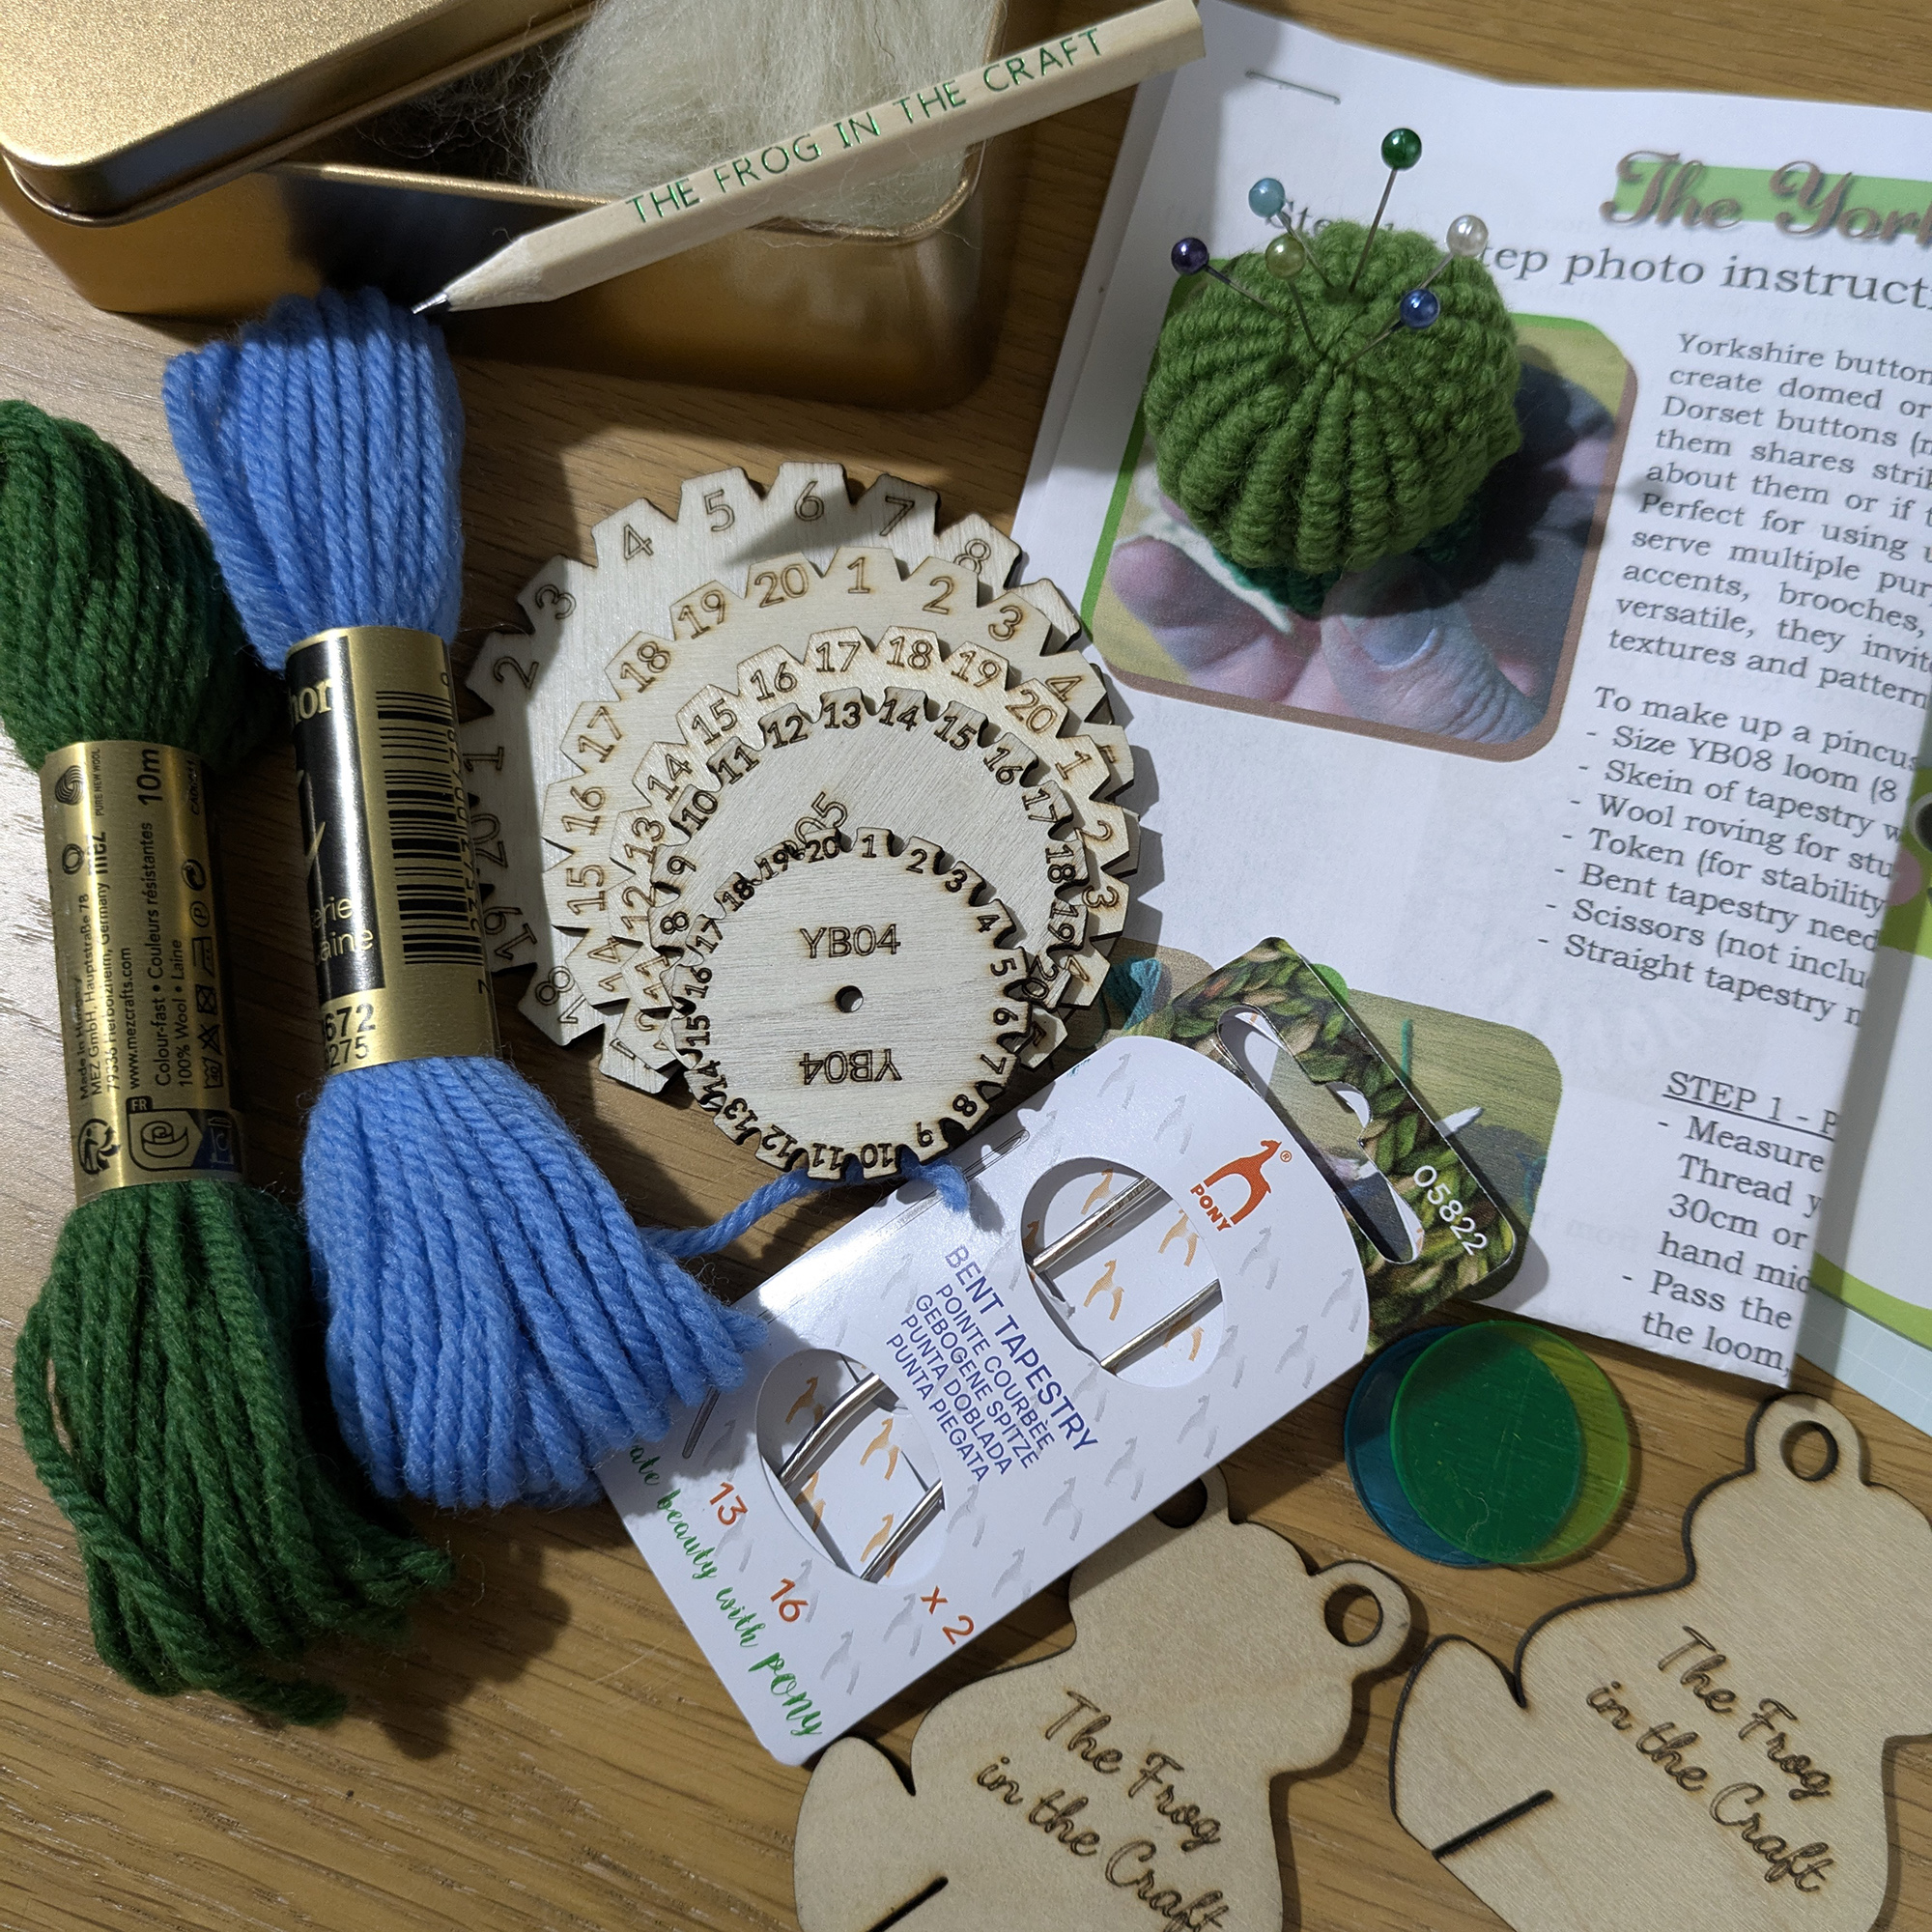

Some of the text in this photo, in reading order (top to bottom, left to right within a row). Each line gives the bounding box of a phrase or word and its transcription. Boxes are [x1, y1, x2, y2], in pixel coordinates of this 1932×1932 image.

[625, 27, 1103, 223] THE FROG IN THE CRAFT
[1600, 151, 1742, 229] The
[1481, 244, 1932, 310] tep photo instruct
[1678, 333, 1825, 367] Yorkshire
[1662, 395, 1765, 427] Dorset
[1777, 409, 1897, 447] buttons
[1669, 368, 1932, 419] create domed or
[1655, 429, 1732, 457] them
[1750, 440, 1855, 474] shares
[703, 488, 735, 532] 5
[795, 480, 825, 523] 6
[879, 495, 916, 537] 7
[1646, 462, 1737, 492] about
[1750, 475, 1830, 505] them
[1845, 494, 1879, 513] or
[1889, 497, 1917, 521] if
[622, 523, 655, 561] 4
[1638, 492, 1745, 527] Perfect
[1760, 509, 1804, 534] for
[1821, 523, 1909, 561] using
[753, 563, 810, 609] 20
[847, 555, 871, 594] 1
[1632, 531, 1932, 608] serve multiple pur
[678, 588, 727, 640] 19
[1622, 563, 1926, 639] accents, brooches,
[815, 639, 862, 673] 17
[886, 635, 934, 671] 18
[1615, 598, 1932, 673] versatile, they invit
[619, 639, 672, 695] 18
[750, 661, 798, 702] 16
[950, 649, 1002, 689] 19
[1607, 629, 1929, 710] textures and pattern
[767, 714, 809, 750] 12
[823, 701, 863, 729] 13
[878, 697, 920, 732] 14
[933, 714, 978, 752] 15
[1005, 688, 1058, 734] 20
[1595, 685, 1632, 713] To
[1641, 700, 1729, 729] make
[1739, 715, 1782, 743] up
[1792, 724, 1811, 744] a
[135, 748, 164, 807] 10m
[983, 746, 1024, 786] 16
[1611, 724, 1898, 807] Size YB08 loom (8
[1604, 758, 1693, 797] Skein
[1703, 780, 1740, 803] of
[1745, 785, 1875, 839] tapestry
[805, 835, 841, 864] 20
[1596, 792, 1675, 829] Wool
[1682, 818, 1788, 856] roving
[1794, 833, 1840, 863] for
[905, 847, 929, 874] 2
[1588, 826, 1888, 920] Token (for stability
[79, 894, 90, 915] 78
[97, 882, 111, 946] Germany
[1578, 862, 1658, 898] Bent
[1665, 880, 1800, 934] tapestry
[141, 822, 172, 1087] Colour-fast Couleurs résistantes
[799, 923, 902, 958] YB04
[1570, 897, 1706, 948] Scissors
[1716, 927, 1780, 965] (not
[80, 915, 98, 1005] Hauptstraße
[1563, 932, 1695, 983] Straight
[1704, 967, 1838, 1023] tapestry
[120, 947, 142, 1092] www.mezcrafts.com
[169, 939, 194, 1088] 100% Wool Laine
[90, 1061, 102, 1095] MEZ
[799, 1048, 903, 1086] YB04
[1665, 1069, 1783, 1122] STEP 1
[130, 1098, 148, 1111] FR
[1685, 1115, 1826, 1173] Measure
[1189, 1183, 1233, 1232] PONY
[1677, 1151, 1794, 1207] Thread
[1413, 1165, 1488, 1256] 05822
[1667, 1192, 1809, 1250] 30cm or
[1657, 1231, 1746, 1277] hand
[935, 1283, 991, 1356] POINTE
[1648, 1269, 1793, 1330] Pass the
[945, 1244, 1099, 1451] BENT TAPESTRY
[1641, 1310, 1694, 1347] the
[886, 1333, 991, 1483] PUNTA PIEGATA
[900, 1314, 1013, 1475] PUNTA DOBLADA
[916, 1293, 1040, 1469] GEBOGENE SPITZE
[708, 1481, 749, 1526] 13
[656, 1488, 719, 1580] beauty
[715, 1586, 766, 1649] with
[770, 1577, 810, 1623] 16
[941, 1614, 976, 1646] 2
[1657, 1624, 1833, 1802] The Frog
[1044, 1690, 1222, 1853] The Frog
[1585, 1680, 1835, 1893] in the Craft
[976, 1756, 1230, 1932] in the Craft
